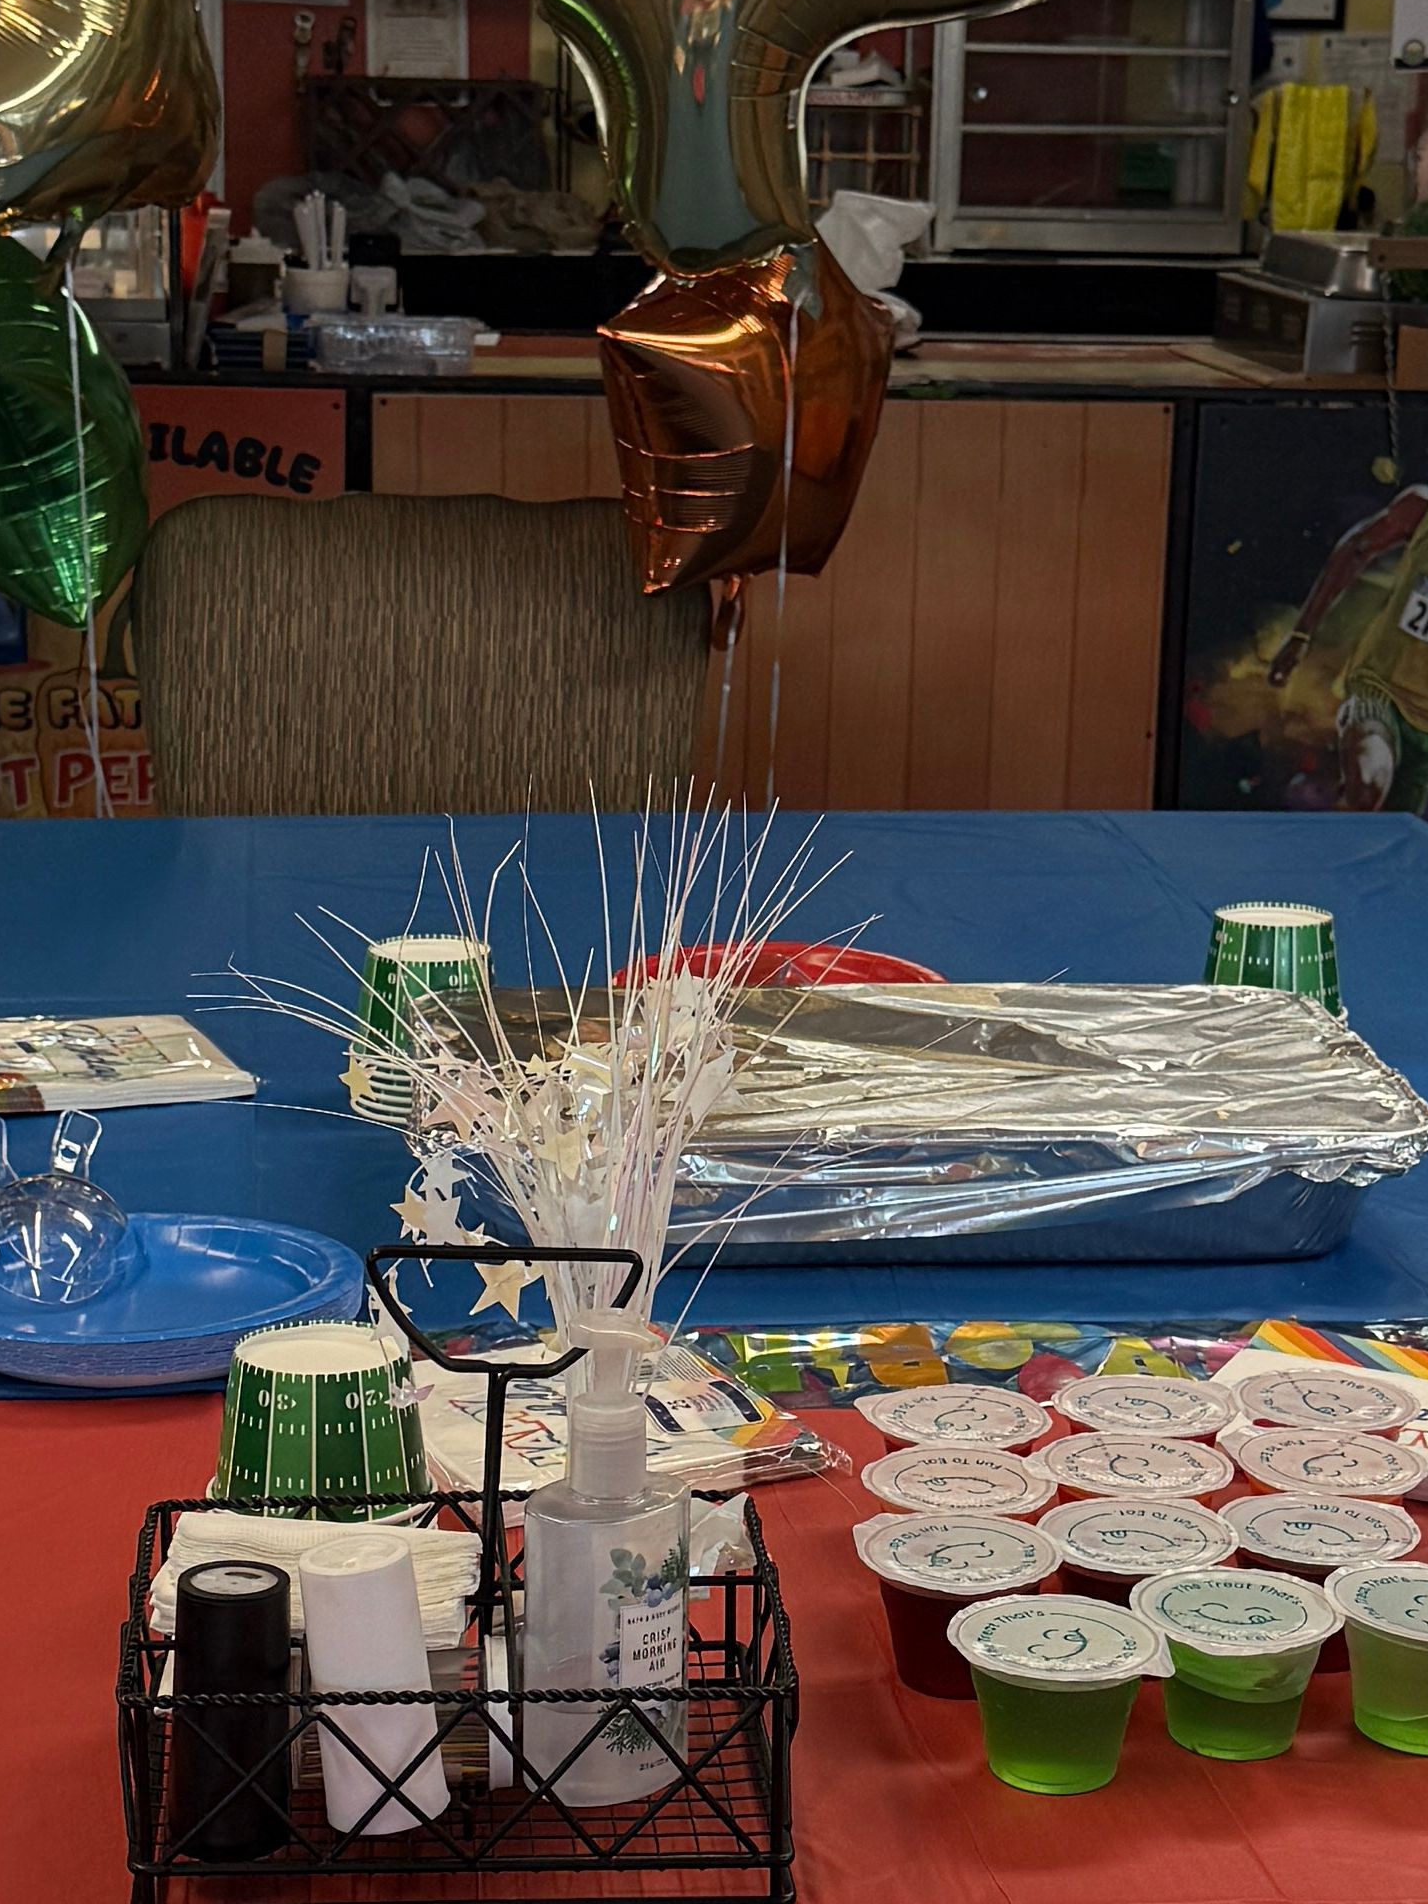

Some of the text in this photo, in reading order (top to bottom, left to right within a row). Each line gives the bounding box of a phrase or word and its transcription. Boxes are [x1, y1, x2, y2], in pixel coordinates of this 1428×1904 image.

[1172, 1582, 1201, 1594] The
[1205, 1580, 1252, 1591] Treat
[632, 1637, 678, 1661] MORNING
